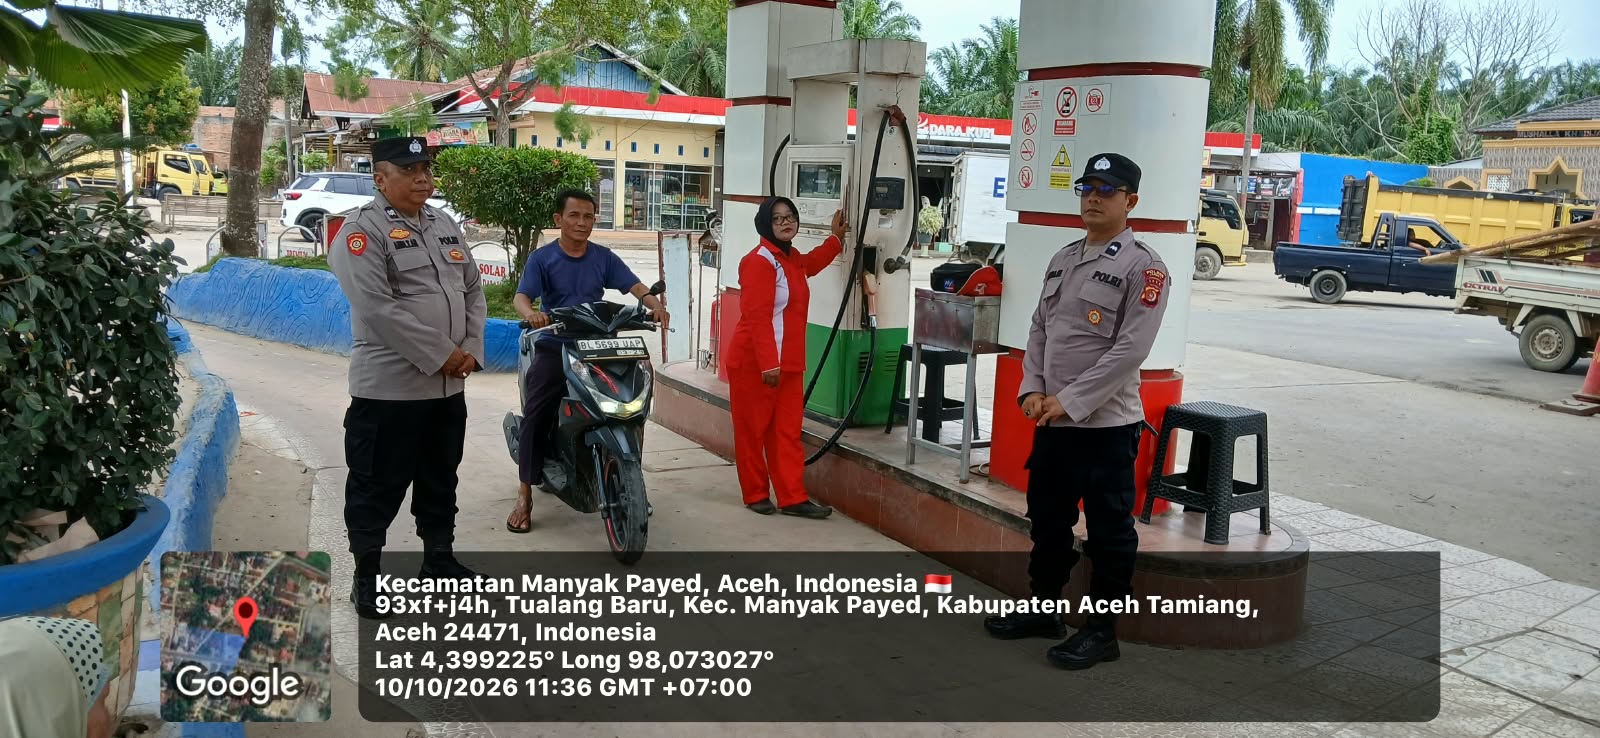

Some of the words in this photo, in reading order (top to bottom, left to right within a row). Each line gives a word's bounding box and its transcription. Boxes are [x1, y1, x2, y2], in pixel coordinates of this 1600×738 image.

[929, 123, 962, 137] DARA
[479, 263, 506, 277] SOLAR
[1092, 270, 1122, 287] POLRI
[580, 341, 595, 350] BL
[595, 340, 619, 349] 5699
[622, 339, 641, 347] UAP
